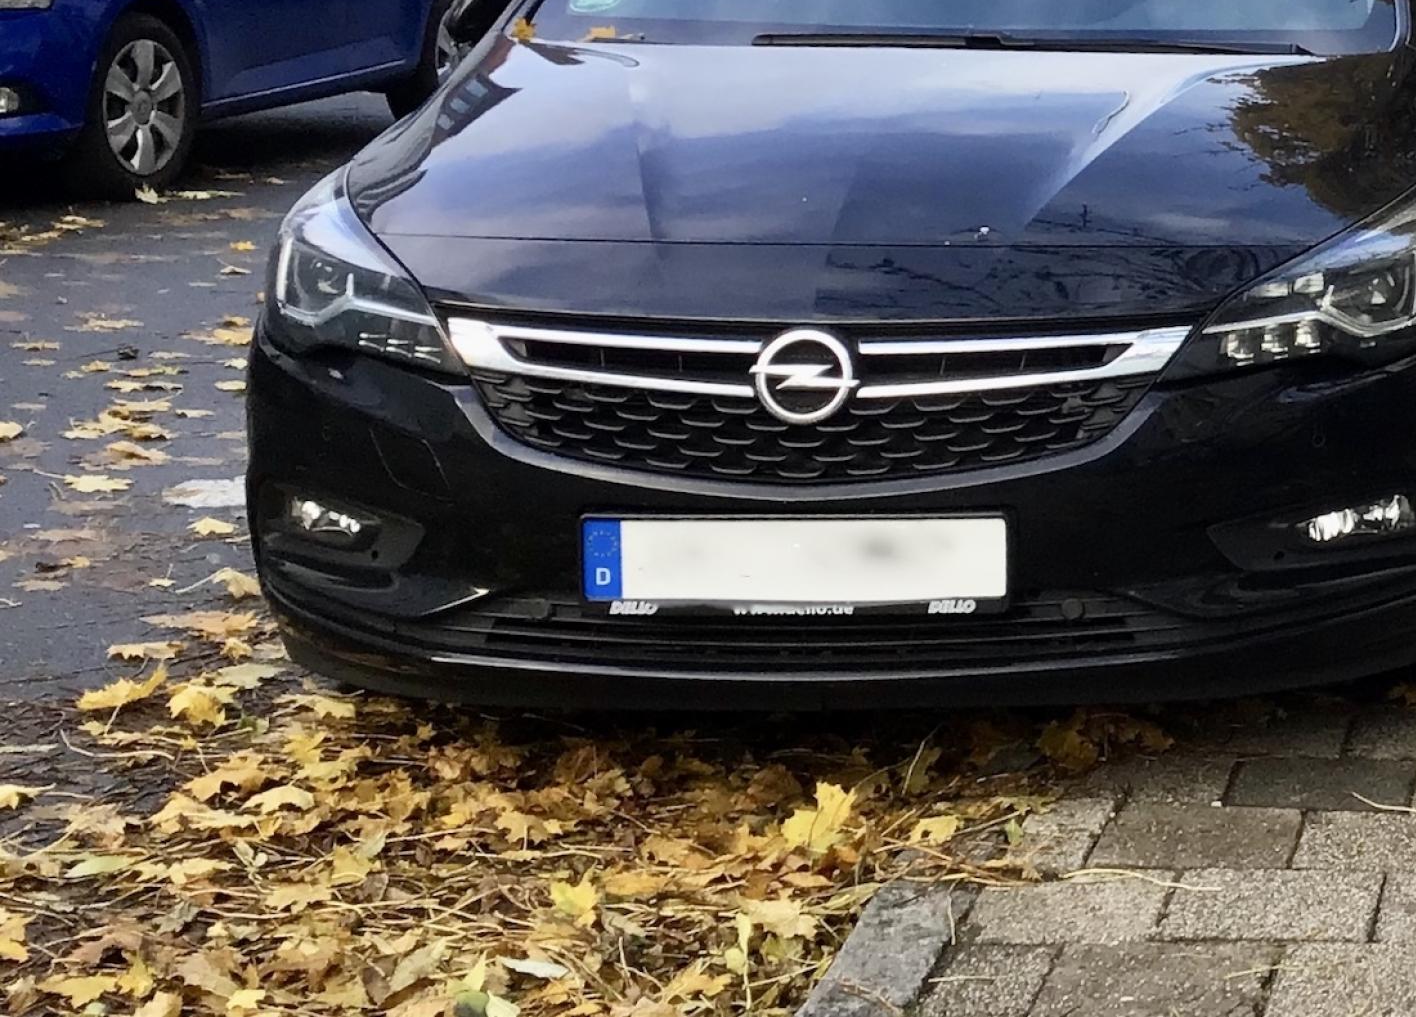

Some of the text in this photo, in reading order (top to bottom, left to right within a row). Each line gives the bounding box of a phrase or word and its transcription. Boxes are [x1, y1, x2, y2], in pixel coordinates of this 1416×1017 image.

[595, 567, 611, 586] D
[609, 600, 660, 616] DELLO
[927, 598, 977, 614] DELLO
